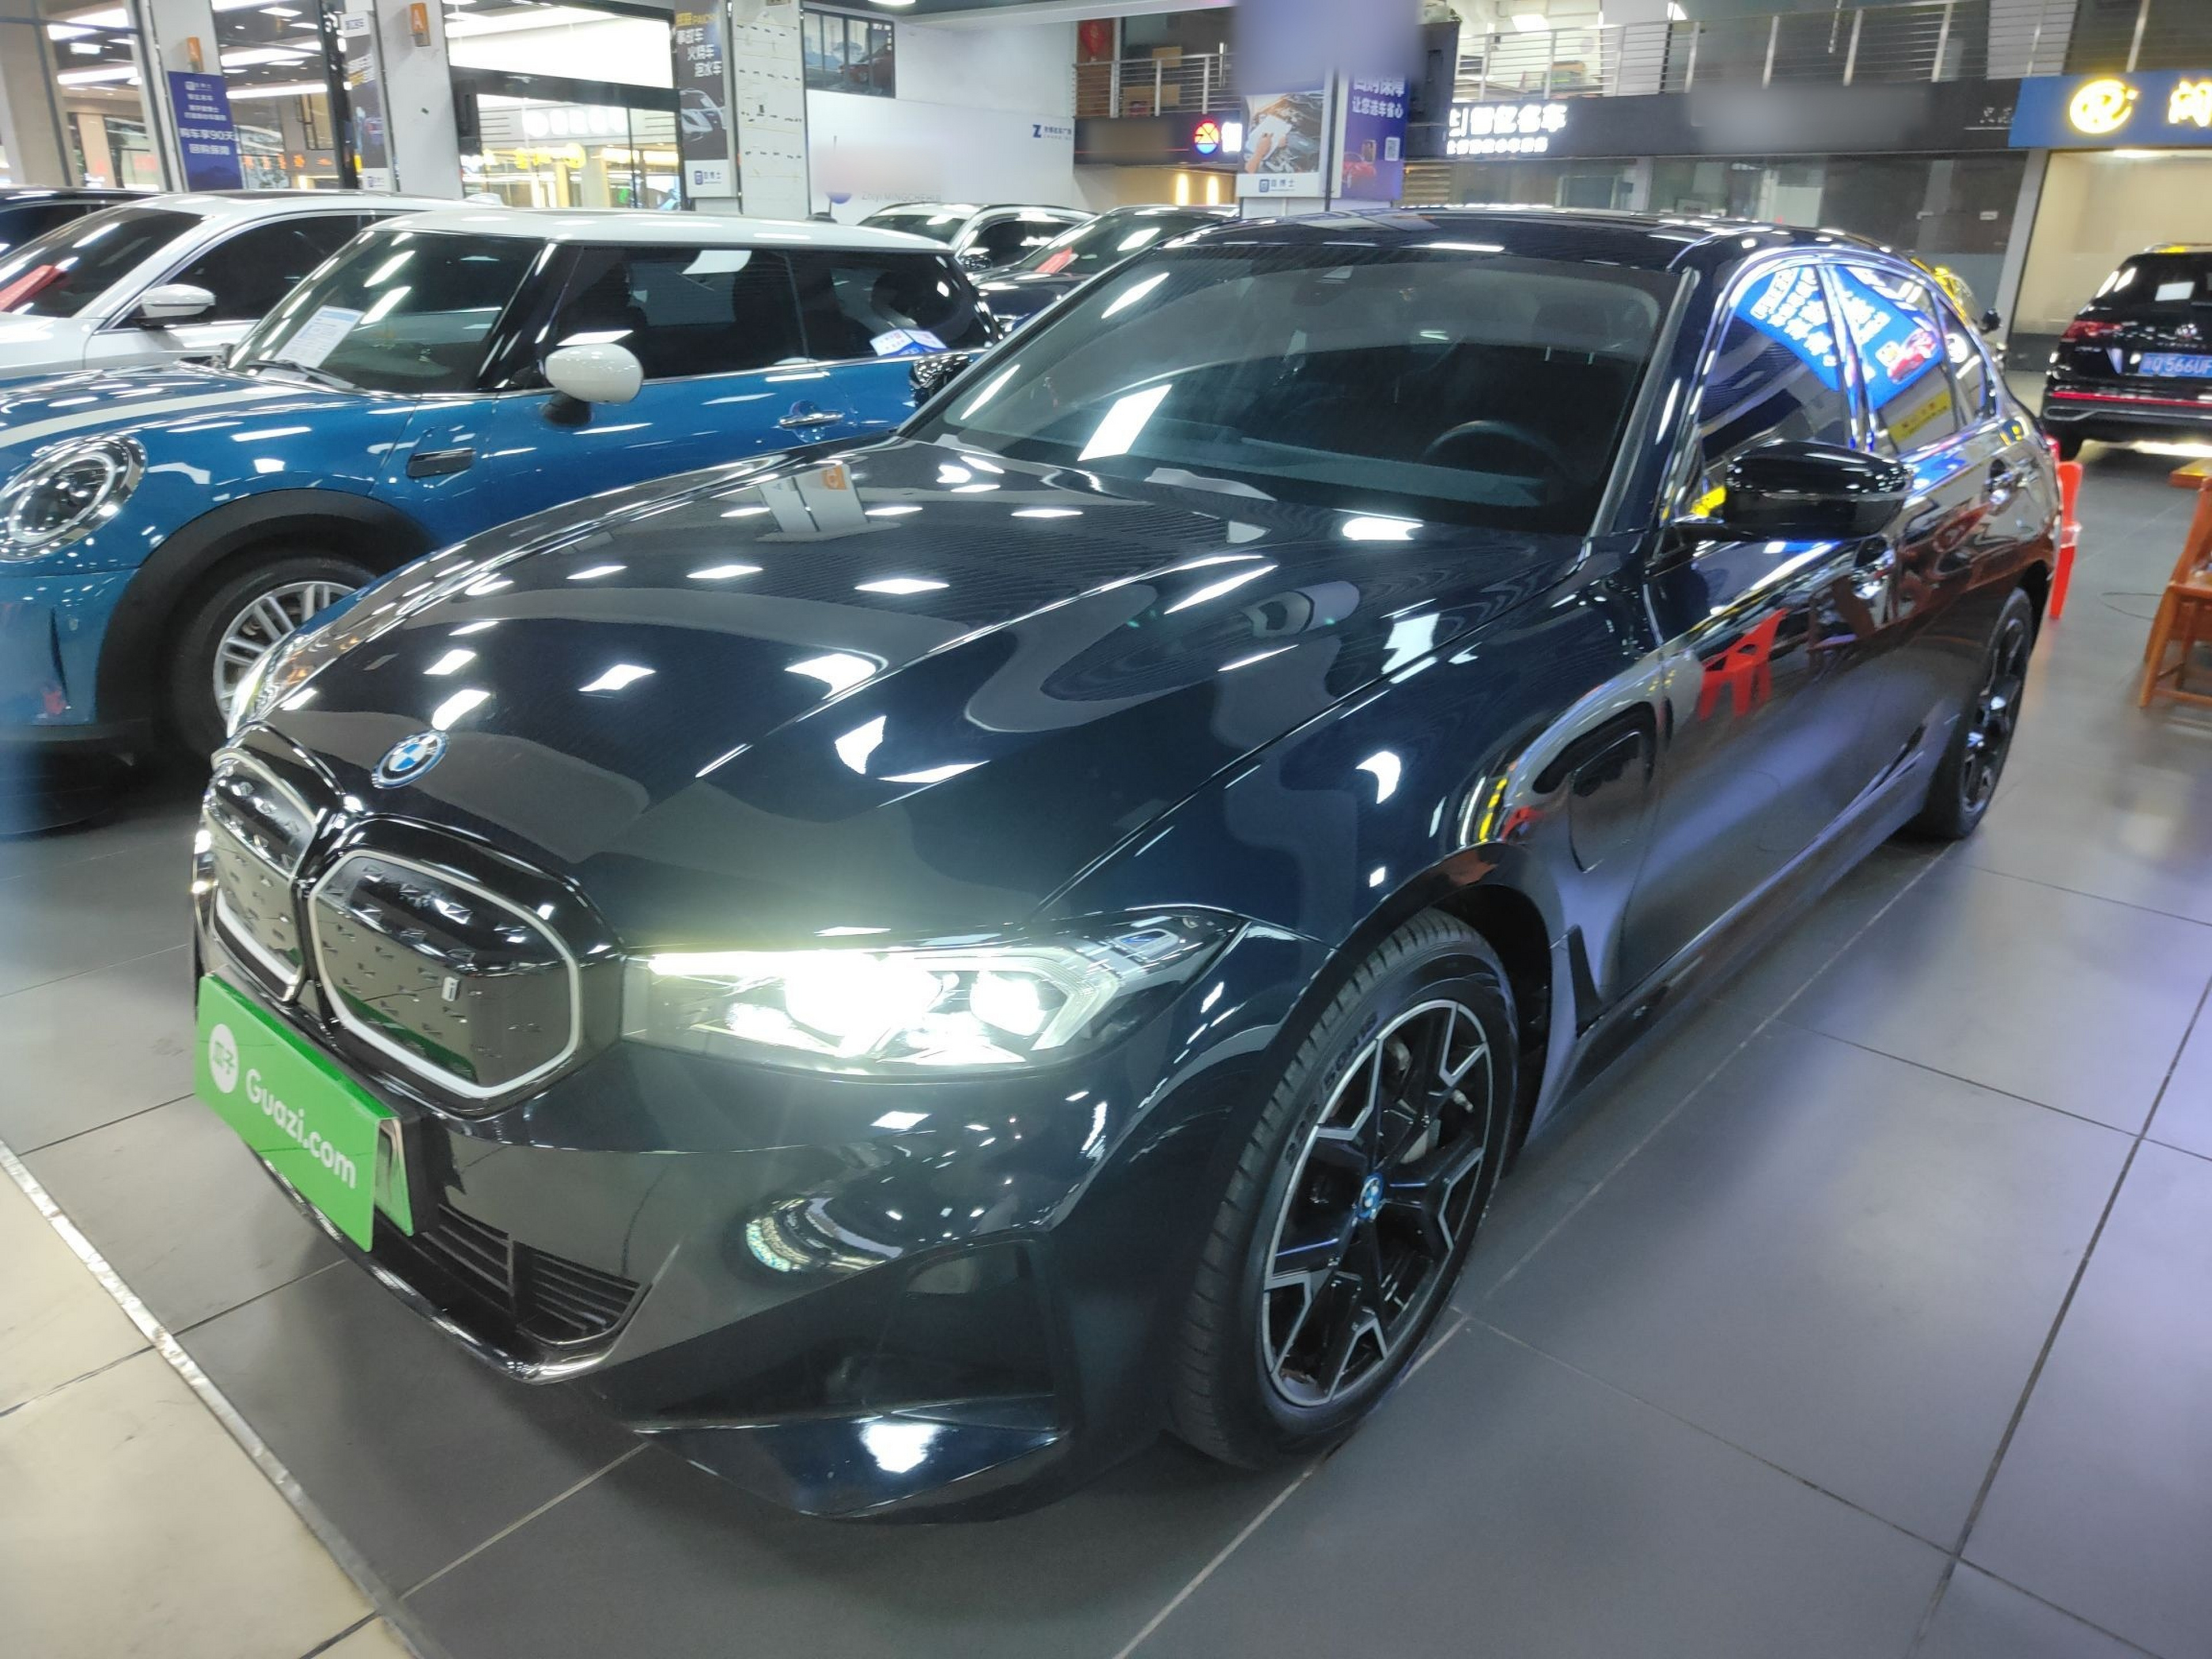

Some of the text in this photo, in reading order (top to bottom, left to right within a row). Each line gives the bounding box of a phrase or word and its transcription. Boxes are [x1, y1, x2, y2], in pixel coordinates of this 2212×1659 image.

[676, 28, 704, 45] 事故车
[687, 44, 715, 61] 火烧车
[694, 60, 722, 78] 泡水车
[1351, 96, 1404, 119] 让您选车省心
[245, 1068, 356, 1190] Guazi.com
